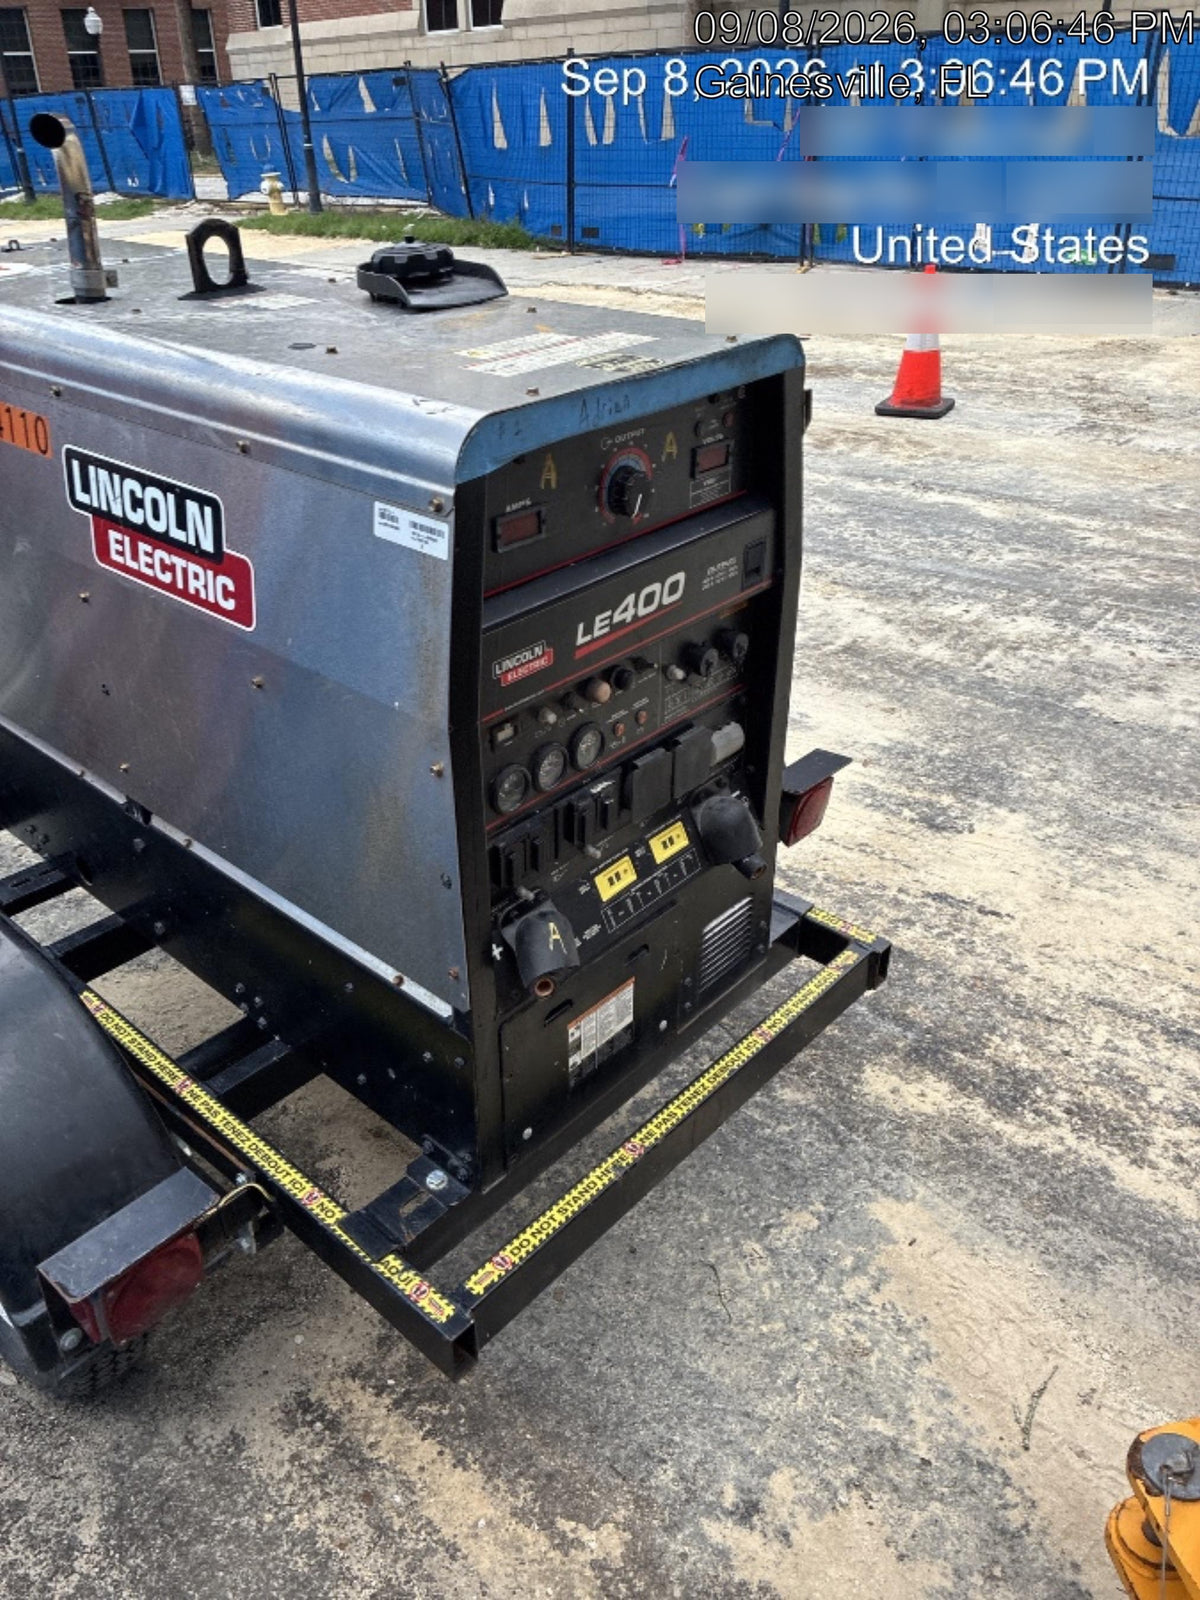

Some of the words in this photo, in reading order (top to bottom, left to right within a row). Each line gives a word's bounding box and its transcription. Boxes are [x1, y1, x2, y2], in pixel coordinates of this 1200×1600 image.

[0, 406, 49, 455] 110
[71, 458, 215, 553] LINCOLN
[108, 529, 236, 610] ELECTRIC
[576, 571, 686, 646] LE400
[495, 644, 544, 675] LINCOLN
[548, 921, 567, 955] A
[99, 1012, 115, 1024] DO
[111, 1022, 131, 1038] NOT
[127, 1037, 158, 1062] STAND
[153, 1060, 180, 1082] HERE
[766, 1017, 782, 1032] NO
[639, 1127, 657, 1144] NE
[654, 1109, 677, 1131] PAS
[675, 1081, 709, 1112] TENEZ
[743, 1037, 760, 1052] ICI
[186, 1088, 202, 1102] NE
[198, 1099, 220, 1117] PAS
[218, 1115, 250, 1143] TENEZ
[247, 1141, 291, 1178] DEBOUT
[288, 1176, 307, 1192] ICI
[315, 1201, 336, 1218] NO
[509, 1237, 531, 1257] DO
[530, 1213, 558, 1239] NOT
[556, 1179, 598, 1216] STAND
